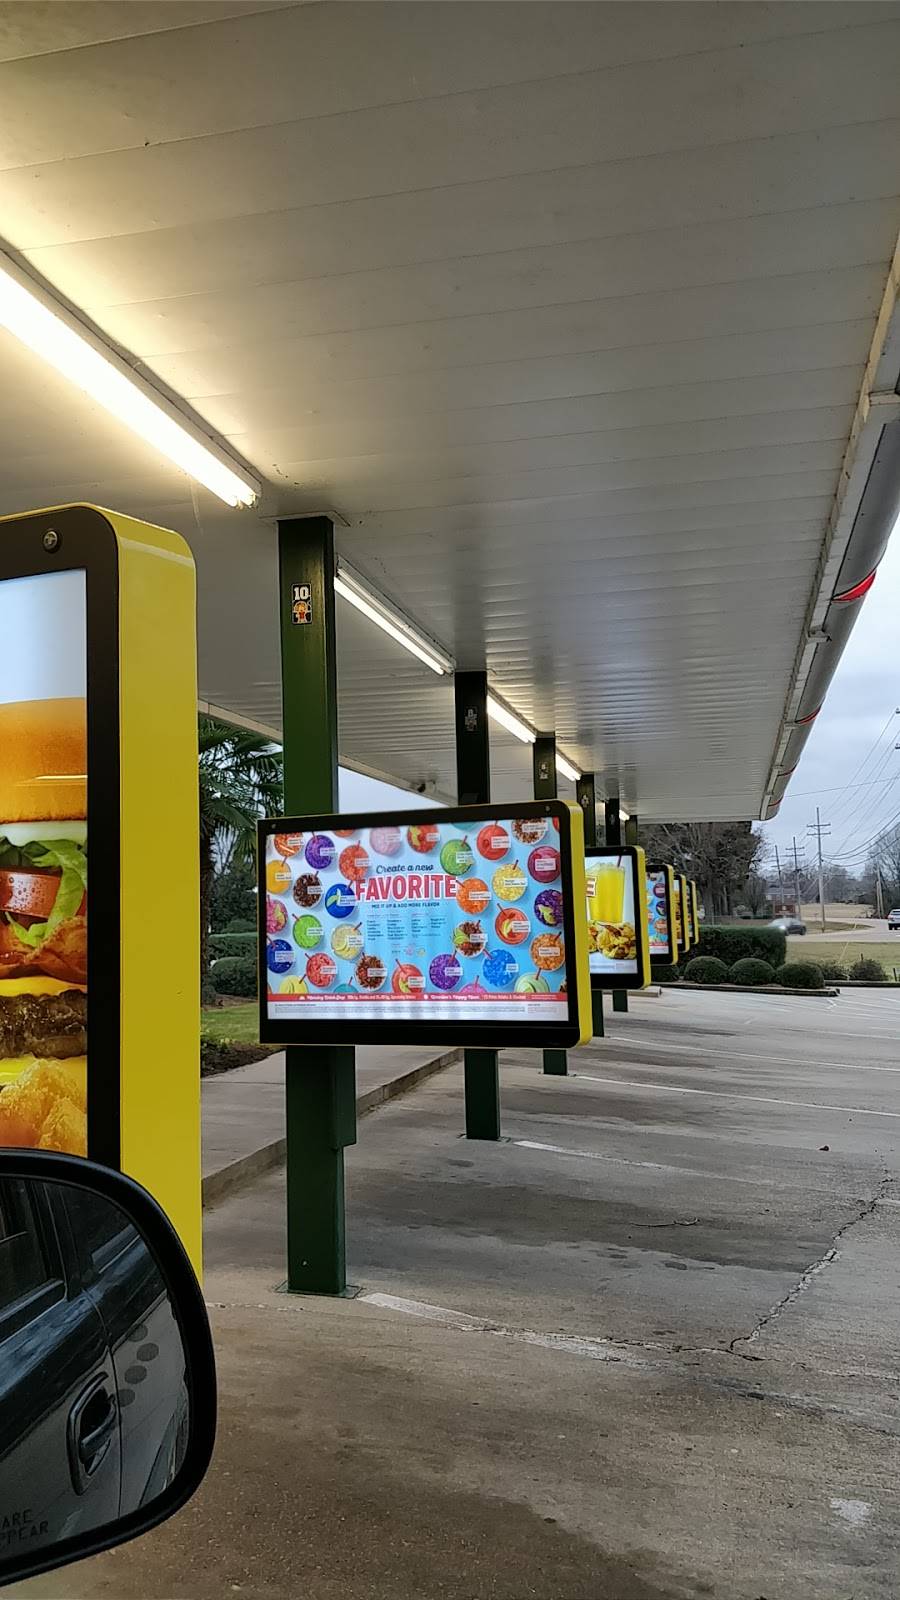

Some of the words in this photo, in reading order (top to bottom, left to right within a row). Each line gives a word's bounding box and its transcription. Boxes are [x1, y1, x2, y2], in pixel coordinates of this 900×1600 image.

[293, 586, 309, 600] 10
[376, 864, 406, 874] Create
[355, 875, 457, 901] FAVORITE
[2, 1509, 33, 1529] ARE
